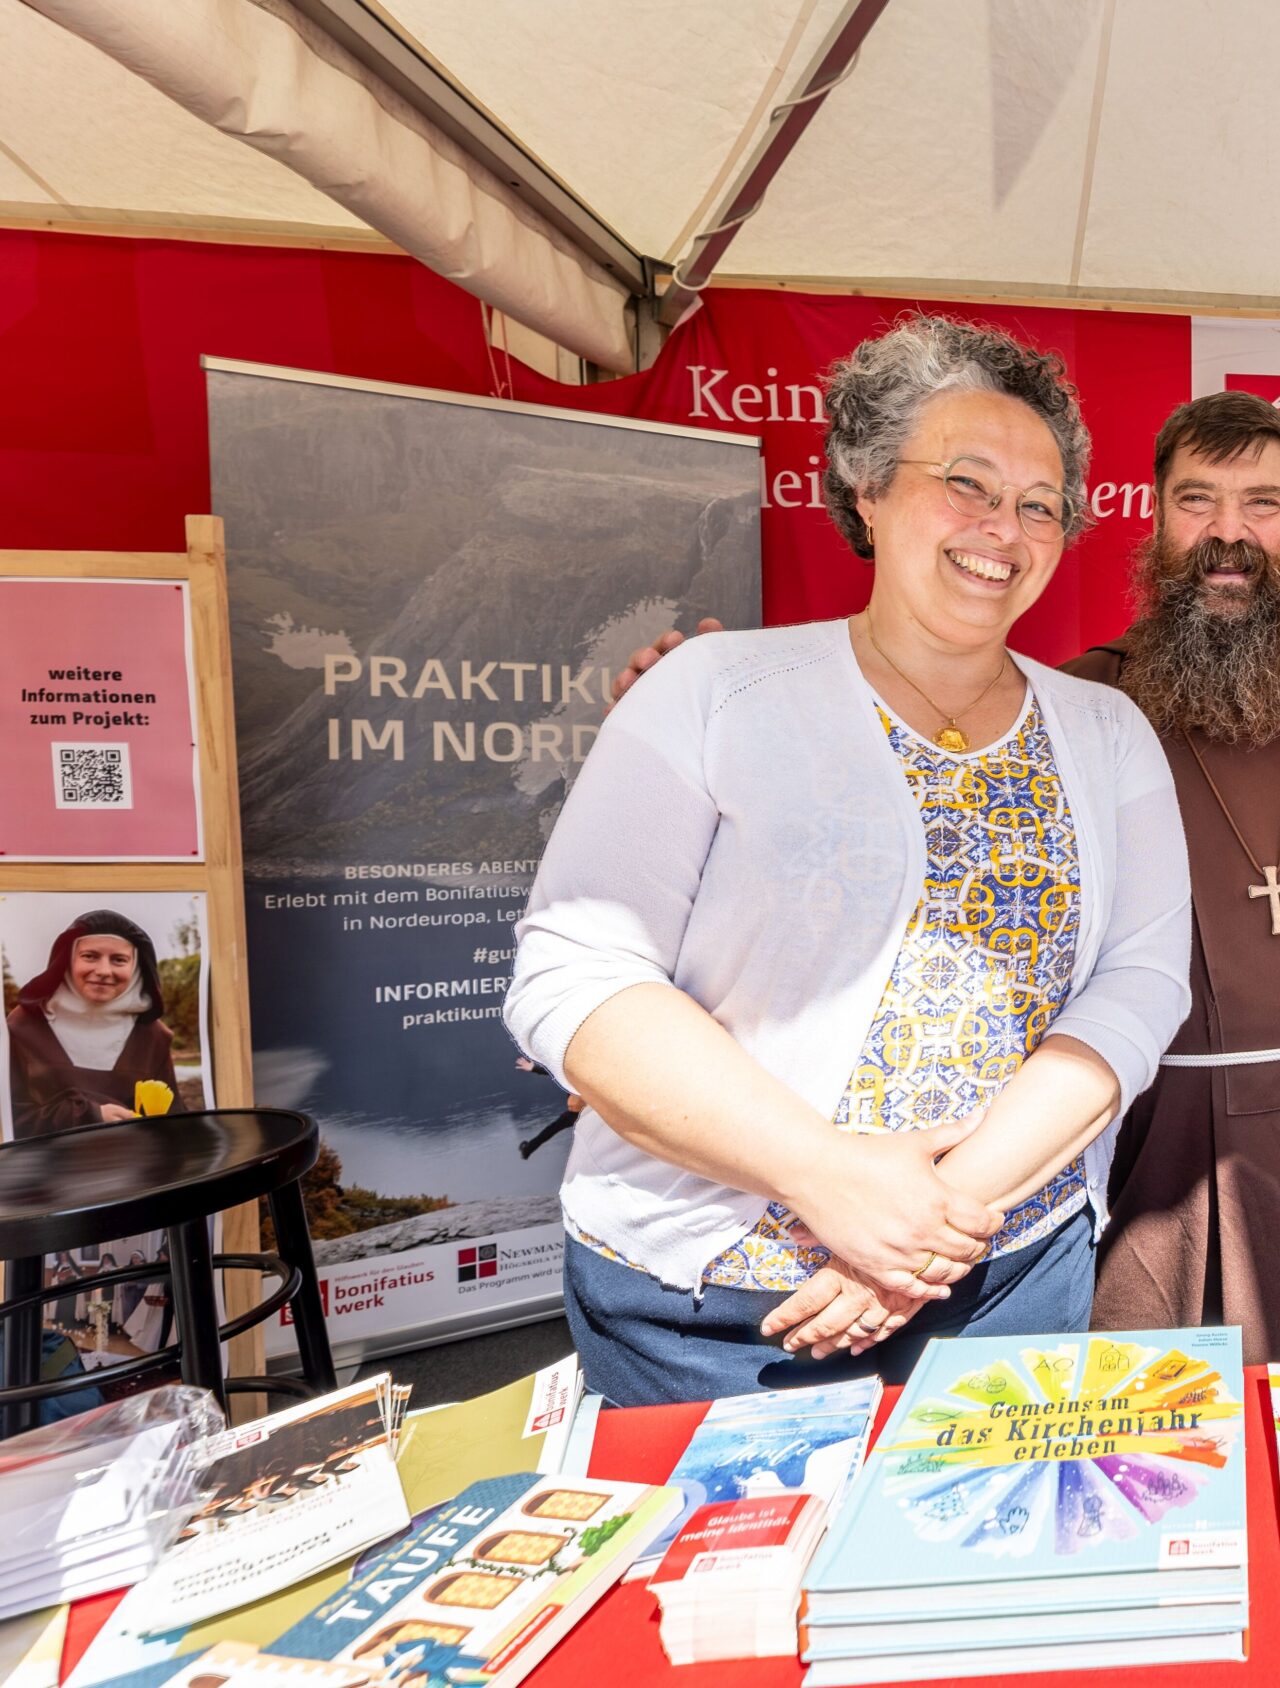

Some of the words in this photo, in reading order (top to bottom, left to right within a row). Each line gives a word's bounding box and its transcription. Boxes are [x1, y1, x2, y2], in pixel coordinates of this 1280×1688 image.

[686, 365, 829, 424] Kein
[48, 666, 123, 681] weitere
[21, 688, 157, 704] Informationen
[30, 714, 67, 725] zum
[72, 711, 150, 729] Projekt:
[328, 718, 404, 760] IM
[433, 721, 600, 762] NORD
[345, 862, 473, 880] BESONDERES
[264, 893, 326, 909] Erlebt
[333, 890, 367, 905] mit
[374, 889, 419, 904] dem
[425, 885, 530, 901] Bonifatiusw
[343, 916, 363, 931] in
[370, 911, 491, 930] Nordeuropa,
[402, 1006, 502, 1029] praktikum
[500, 1242, 564, 1261] NEWMAN
[334, 1269, 435, 1301] bonifatius
[458, 1285, 477, 1295] Das
[478, 1272, 530, 1293] Programm
[532, 1268, 553, 1278] wird
[334, 1294, 384, 1316] werk
[990, 1397, 1130, 1420] Gemeinsam
[936, 1424, 993, 1448] das
[1006, 1409, 1203, 1443] Kirchenjahr
[1014, 1438, 1116, 1461] erleben
[707, 1509, 756, 1528] Glaube
[758, 1507, 776, 1519] ist
[679, 1526, 728, 1544] meine
[326, 1504, 495, 1626] TAUFE
